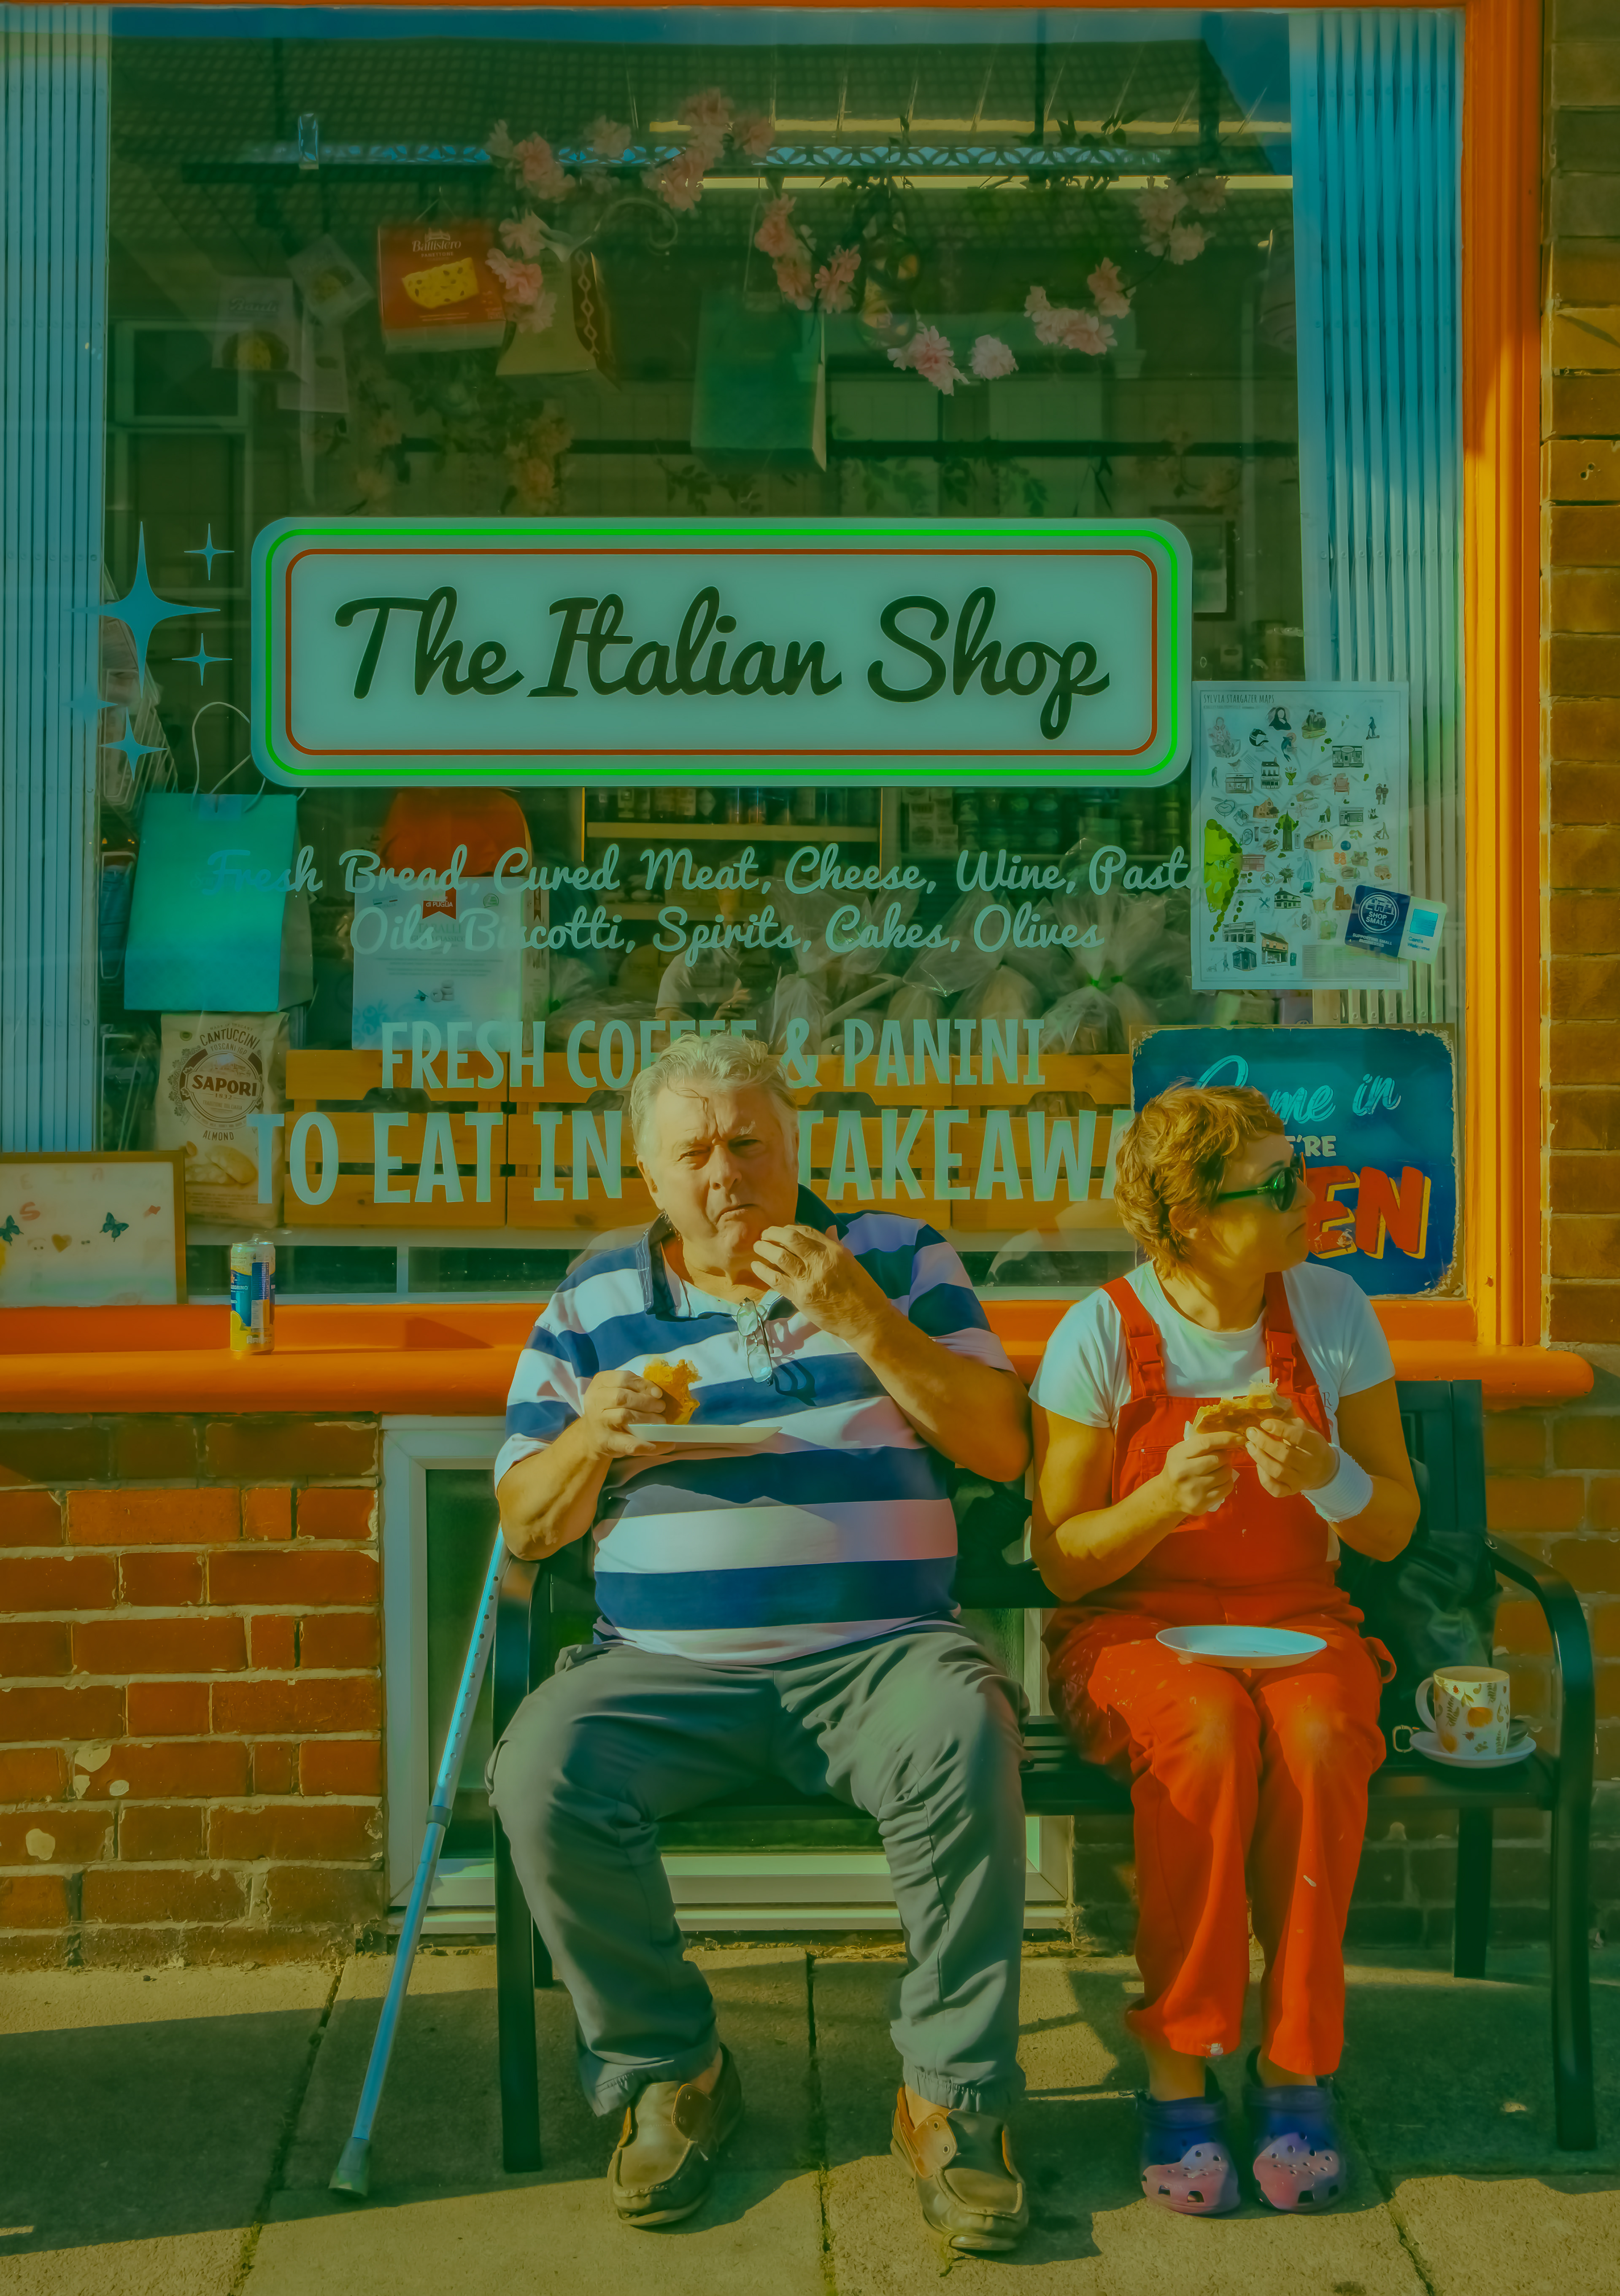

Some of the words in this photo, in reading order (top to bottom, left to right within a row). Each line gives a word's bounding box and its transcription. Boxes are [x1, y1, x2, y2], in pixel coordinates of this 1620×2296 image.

[334, 586, 525, 699] The
[528, 585, 842, 698] Italian
[866, 586, 1110, 740] Shop
[1203, 694, 1225, 704] SYLVIA
[1226, 694, 1258, 703] STARGAZER
[1259, 694, 1274, 703] MAPS
[201, 845, 323, 896] Fresh
[338, 844, 480, 896] Bread,
[493, 844, 620, 895] Cured
[640, 846, 772, 895] Meat,
[784, 843, 936, 895] Cheese,
[956, 848, 1077, 894] Wine,
[1366, 917, 1387, 927] SMALL
[1368, 911, 1387, 920] SHOP
[350, 904, 453, 955] Oils,
[459, 905, 636, 953] Biscotti,
[653, 905, 813, 967] Spirits,
[825, 902, 959, 953] Cakes,
[973, 902, 1105, 952] Olives
[200, 1028, 261, 1050] CANTUCCINI
[211, 1043, 236, 1052] TOSCANI
[237, 1047, 248, 1055] IGP
[381, 1020, 546, 1089] FRESH
[780, 1017, 821, 1088] &
[843, 1018, 1046, 1087] PANINI
[192, 1074, 257, 1097] SAPORI
[1353, 1073, 1401, 1117] in
[202, 1130, 235, 1141] ALMOND
[246, 1112, 339, 1206] TO
[374, 1111, 504, 1204] EAT
[532, 1110, 623, 1201] IN
[798, 1109, 1134, 1202] TAKEAW
[1305, 1165, 1432, 1260] EN
